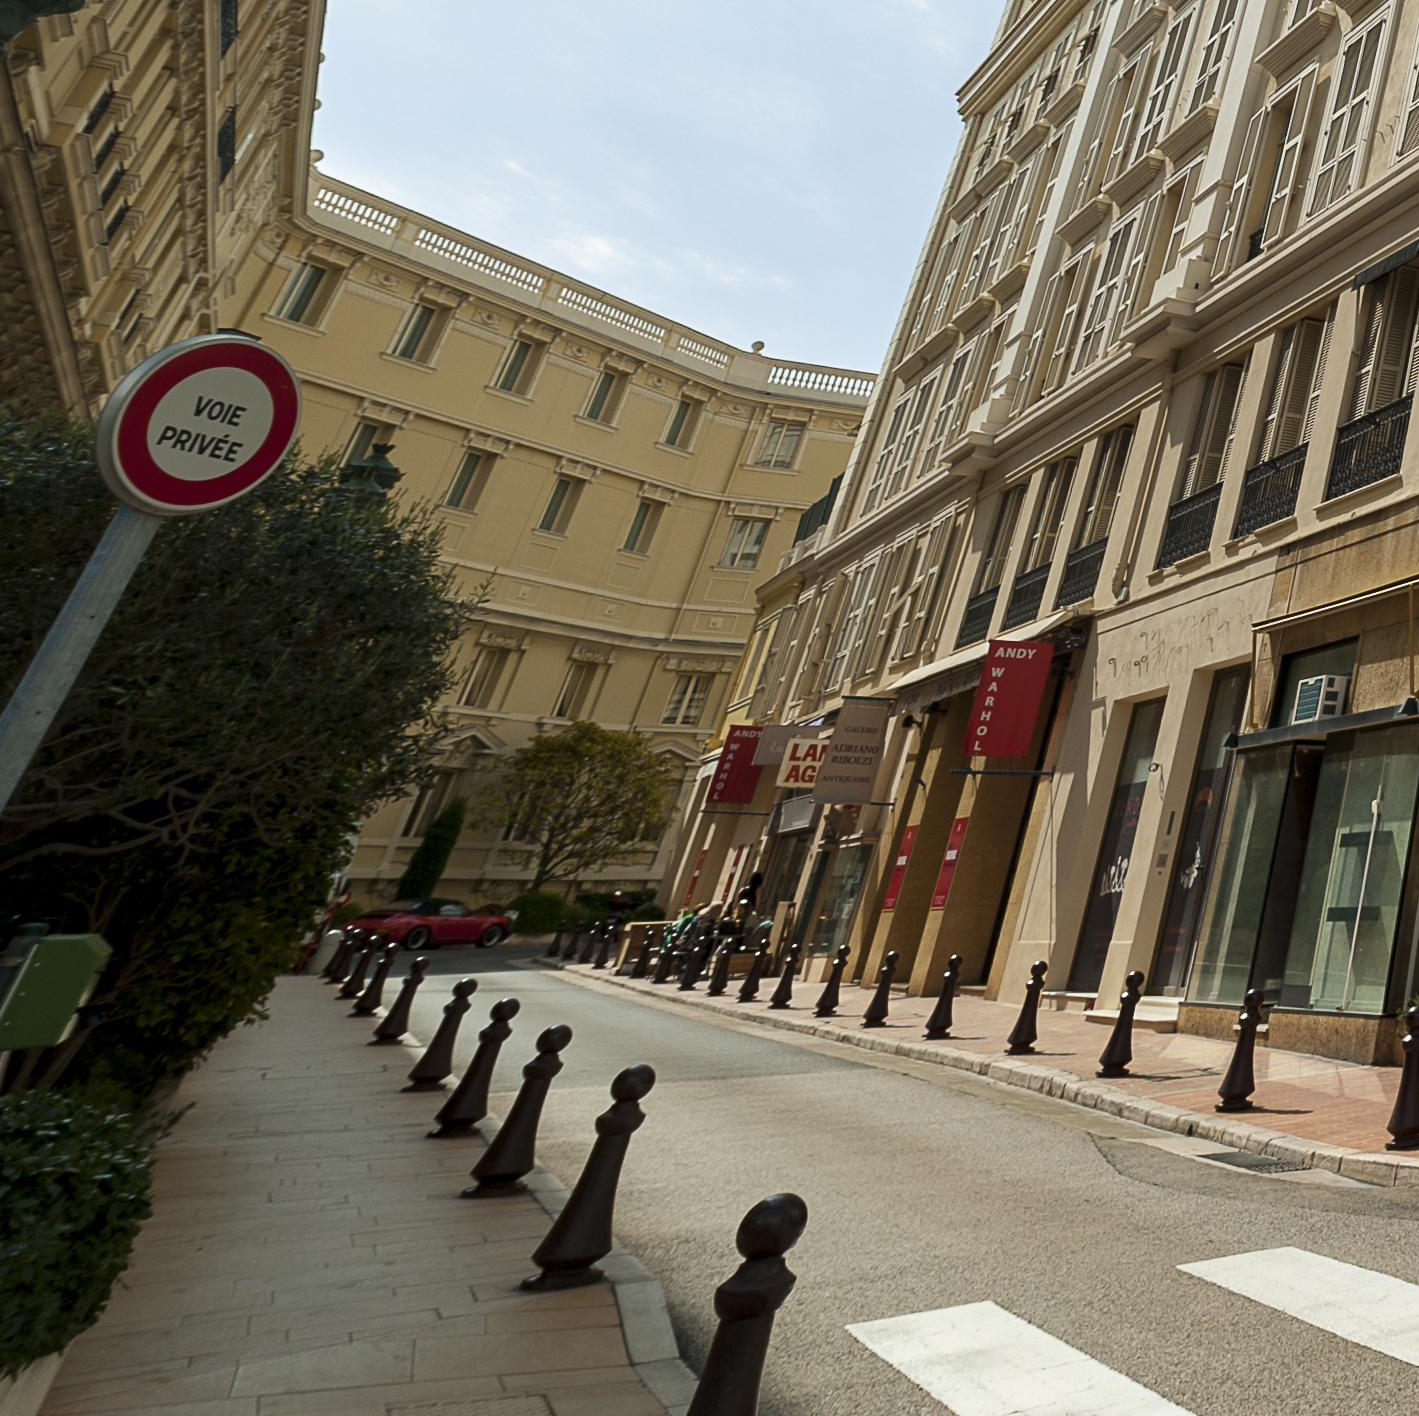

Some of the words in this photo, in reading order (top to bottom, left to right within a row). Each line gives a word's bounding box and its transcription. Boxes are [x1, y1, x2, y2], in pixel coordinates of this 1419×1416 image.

[193, 395, 248, 427] VOIE
[155, 425, 244, 463] PRIVÉE
[994, 647, 1038, 660] ANDY
[973, 667, 1006, 752] WARHOL
[733, 729, 762, 738] ANDY
[845, 725, 878, 734] GALERIE
[831, 743, 879, 754] ADRIANO
[831, 755, 874, 765] RIBOLZI
[712, 743, 741, 800] WARHOL
[820, 775, 871, 784] ANTIQUAIRE
